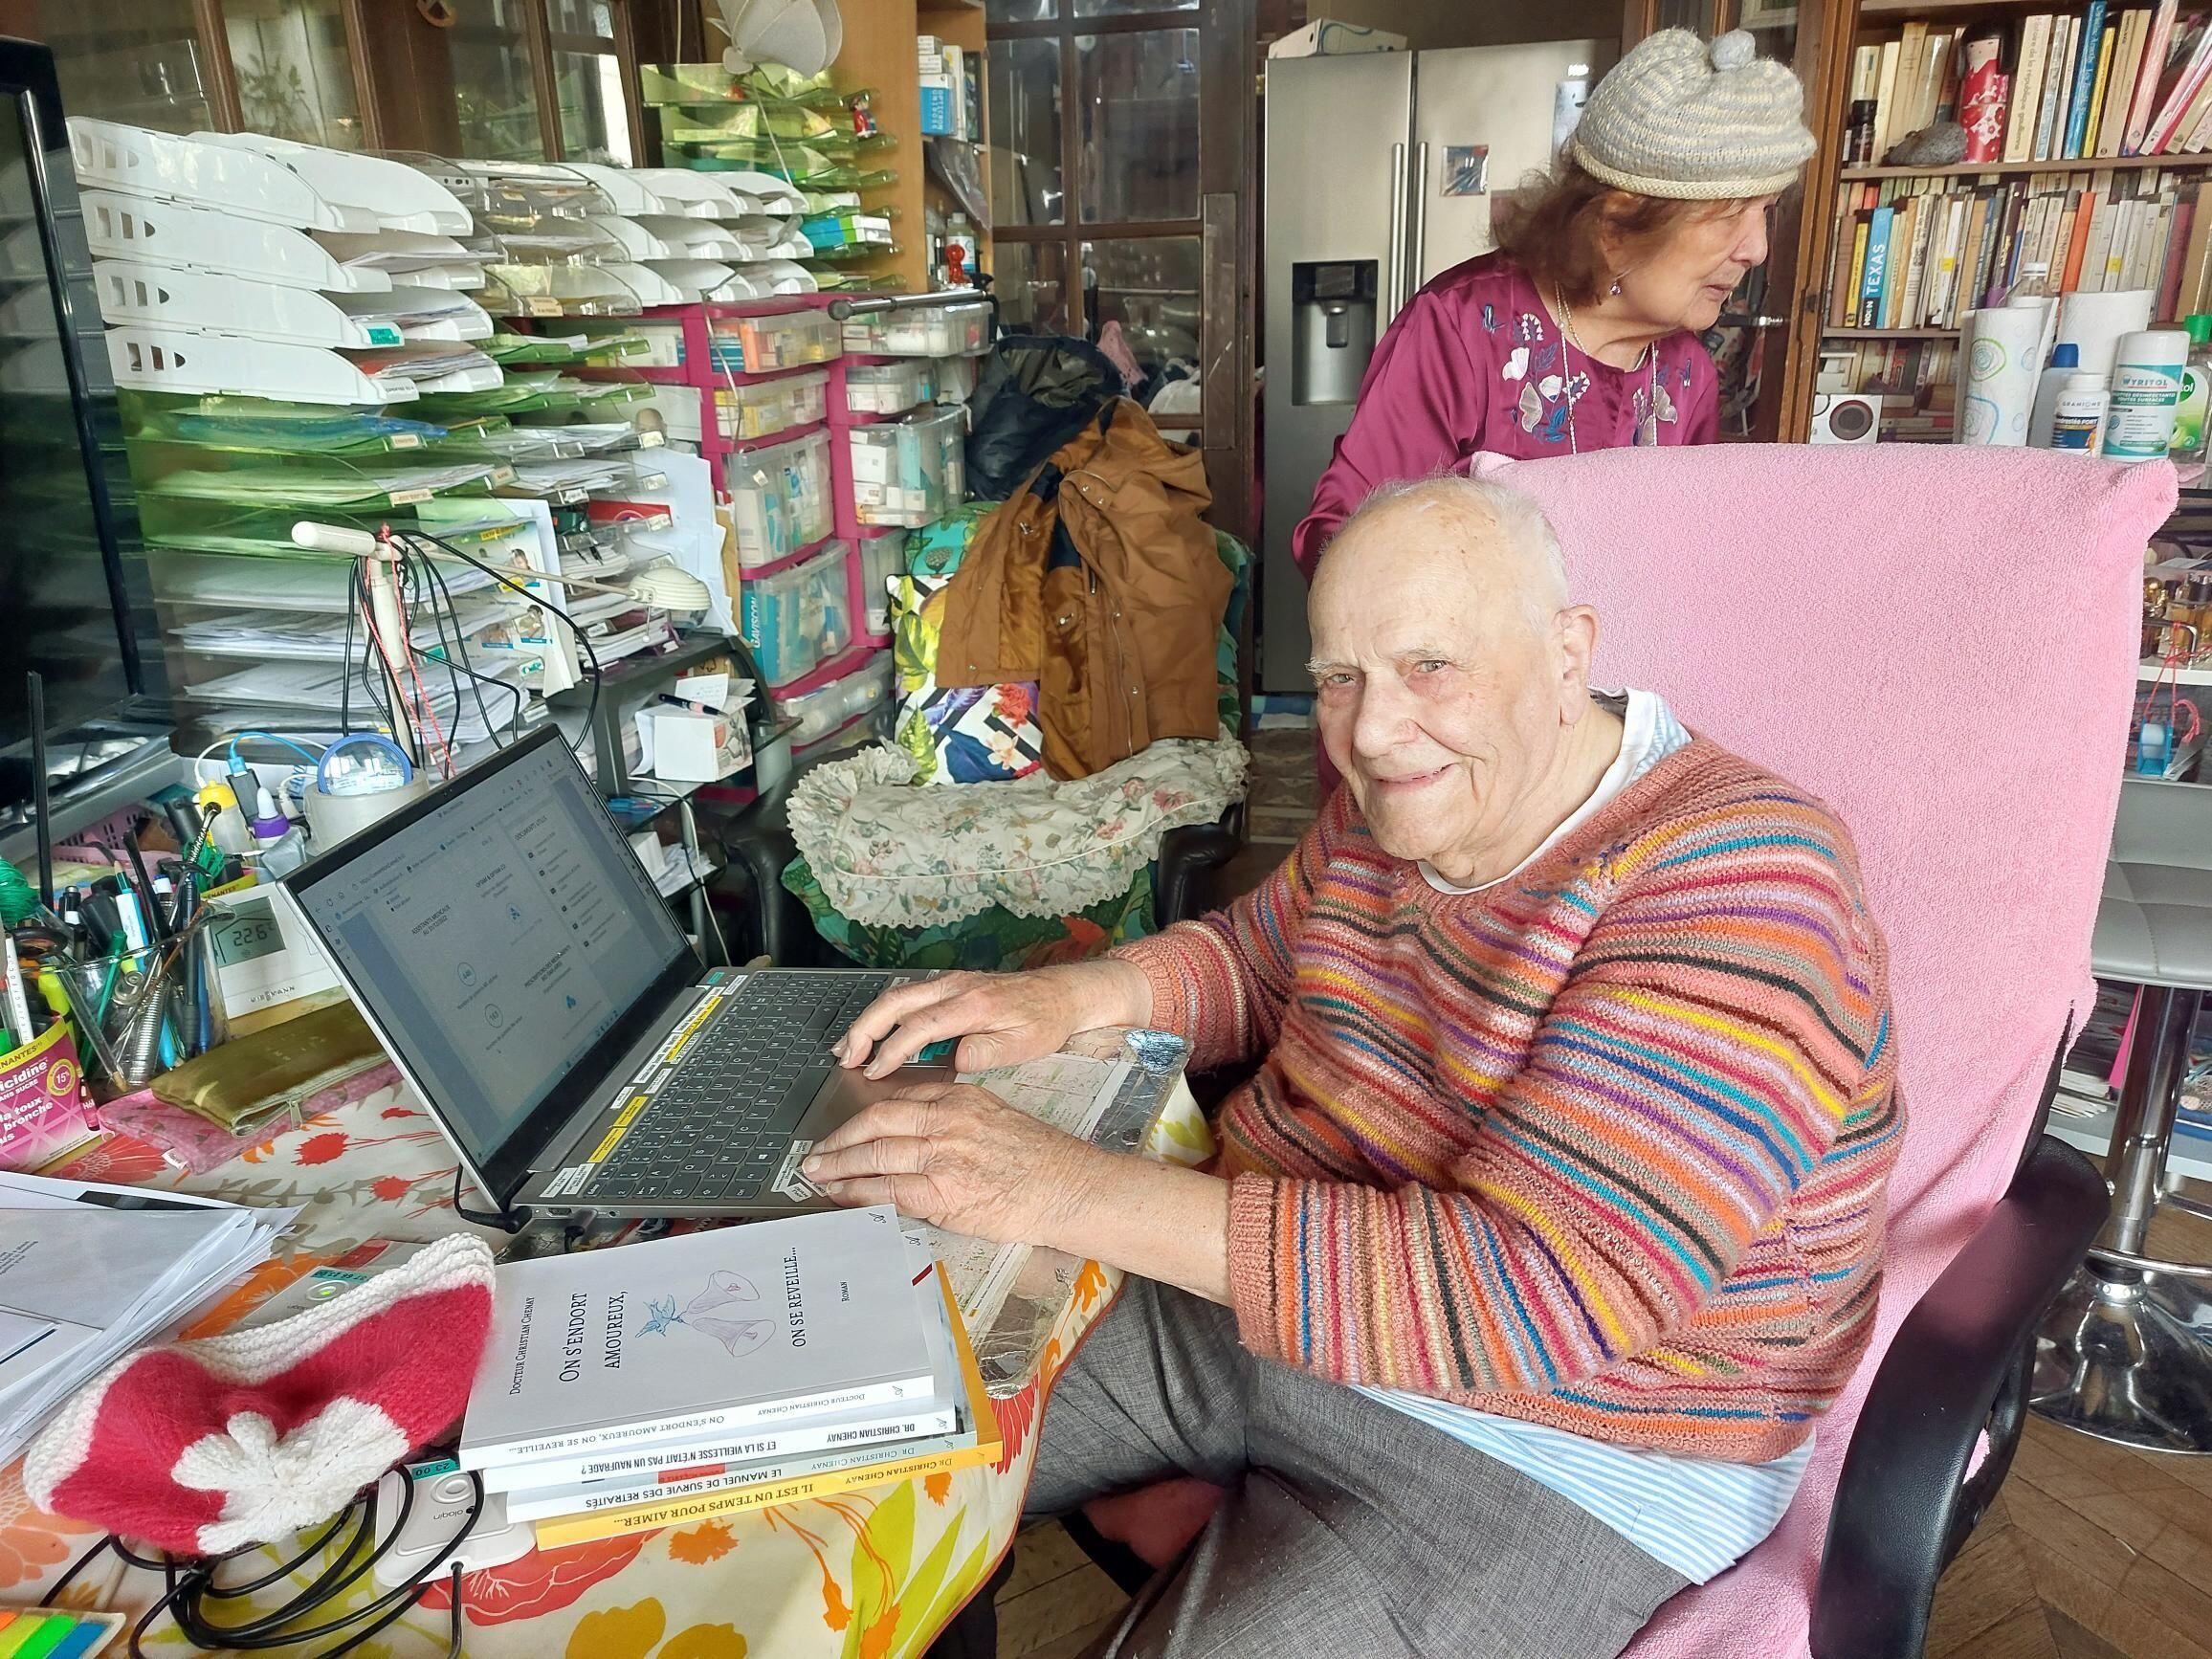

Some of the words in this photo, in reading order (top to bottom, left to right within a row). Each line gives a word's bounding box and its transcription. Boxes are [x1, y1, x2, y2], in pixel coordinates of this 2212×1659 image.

[1866, 244, 1886, 296] TEXAS
[748, 597, 760, 648] GAVISCON
[0, 1060, 48, 1091] icidine
[0, 1092, 15, 1102] ANS
[15, 1078, 38, 1092] SUCRE
[15, 1096, 43, 1115] toux
[4, 1102, 54, 1132] bronche
[0, 1132, 15, 1145] us
[840, 1281, 850, 1302] ROMAN
[521, 1297, 535, 1324] CHENAY
[563, 1293, 587, 1356] S'ENDORT
[789, 1311, 804, 1326] SE
[605, 1291, 629, 1368] AMOUREUX,
[516, 1324, 531, 1360] CHRISTIAN
[792, 1328, 807, 1347] ON
[509, 1360, 525, 1395] DOCTEUR
[559, 1360, 582, 1382] ON
[789, 1399, 830, 1410] CHRISTIAN
[831, 1393, 865, 1404] DOCTEUR
[758, 1405, 788, 1416] CHENAY
[659, 1418, 707, 1432] S'ENDORT
[710, 1415, 725, 1424] ON
[598, 1425, 657, 1441] AMOUREUX,
[859, 1425, 900, 1438] CHRISTIAN
[901, 1423, 915, 1432] DR.
[567, 1437, 579, 1446] SE
[581, 1435, 596, 1444] ON
[827, 1429, 857, 1443] CHENAY
[745, 1444, 755, 1453] LA
[757, 1443, 764, 1451] SI
[766, 1441, 776, 1450] ET
[901, 1447, 915, 1455] DR
[648, 1454, 663, 1466] PAS
[698, 1446, 742, 1460] VIEILLESSE
[850, 1449, 897, 1463] CHRISTIAN
[435, 1462, 451, 1472] 23
[588, 1459, 631, 1473] NAUFRAGE
[633, 1457, 646, 1467] UN
[811, 1457, 848, 1470] CHENAY
[886, 1461, 938, 1476] CHRISTIAN
[939, 1458, 952, 1467] DR
[416, 1467, 431, 1478] 00
[724, 1470, 767, 1485] MANUEL
[771, 1469, 782, 1478] LE
[845, 1471, 884, 1485] CHENAY
[669, 1481, 703, 1495] SURVIE
[706, 1479, 719, 1489] DE
[801, 1484, 813, 1493] IL
[643, 1487, 663, 1498] DES
[755, 1492, 774, 1503] UN
[776, 1487, 799, 1498] EST
[586, 1491, 640, 1509] RETRAITÉS
[709, 1495, 754, 1512] TEMPS
[671, 1504, 705, 1517] POUR
